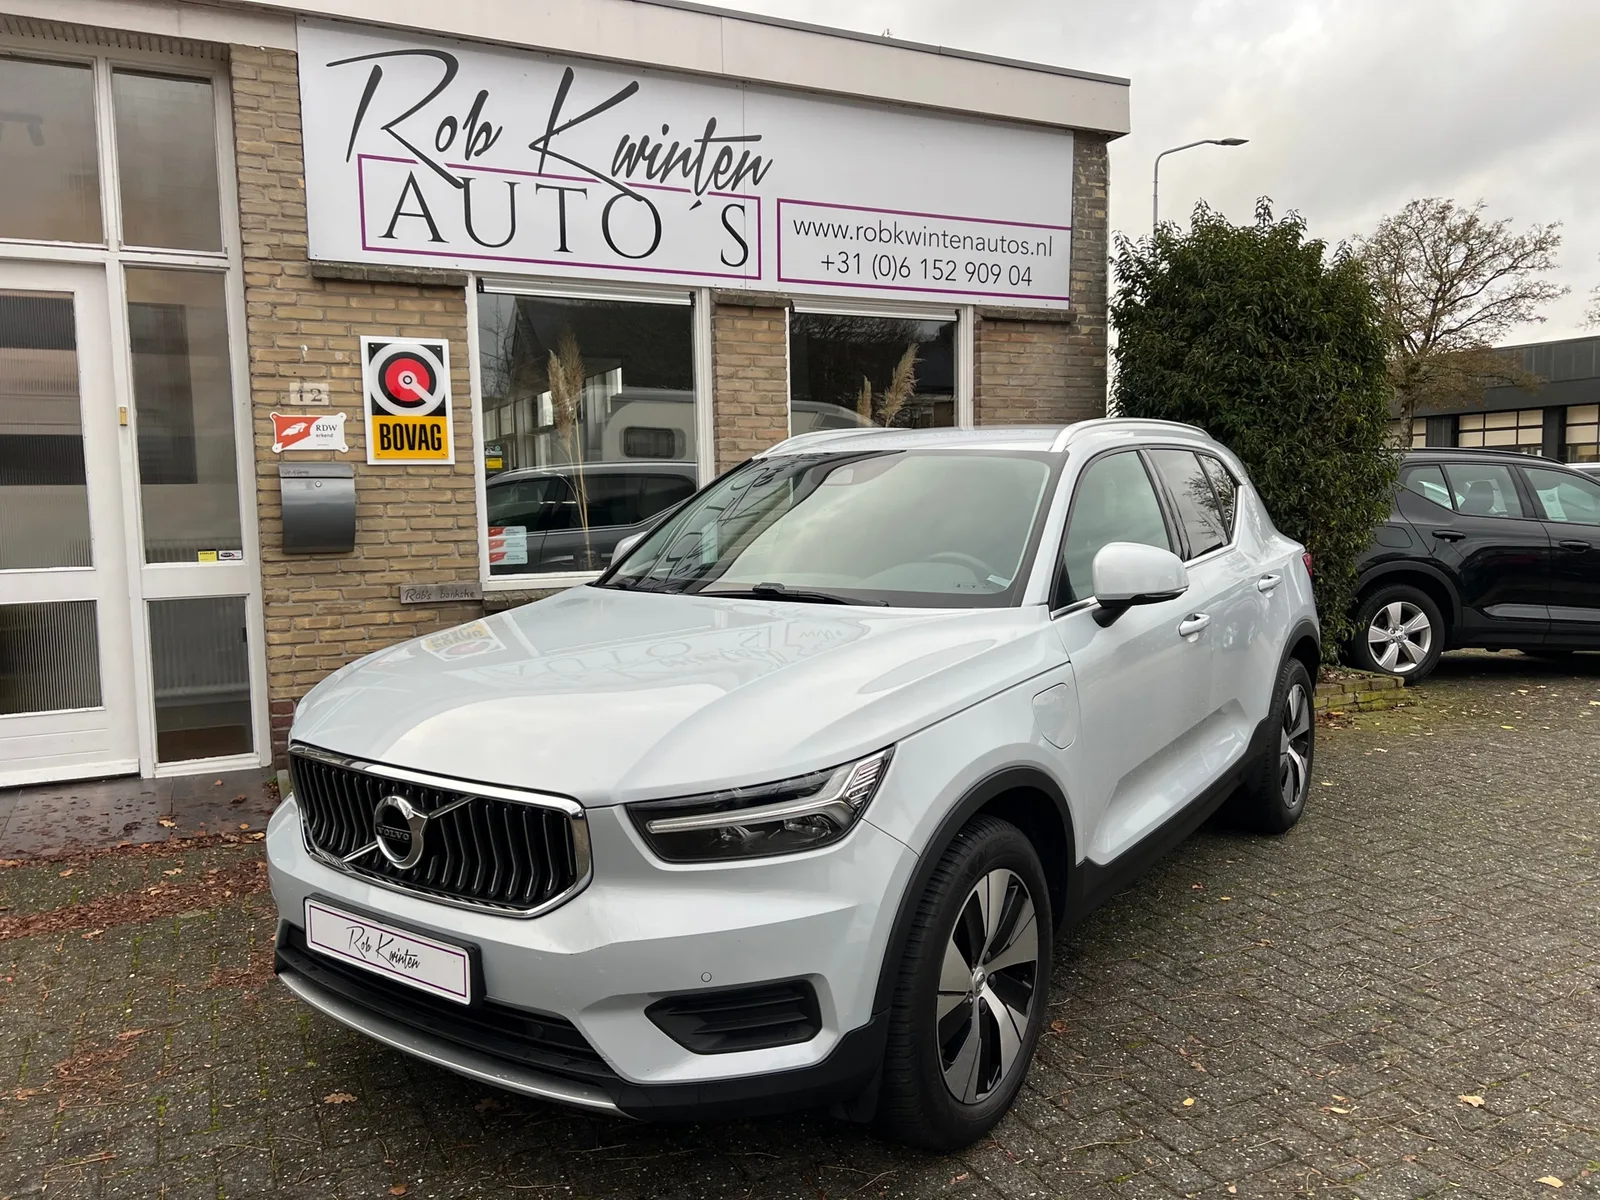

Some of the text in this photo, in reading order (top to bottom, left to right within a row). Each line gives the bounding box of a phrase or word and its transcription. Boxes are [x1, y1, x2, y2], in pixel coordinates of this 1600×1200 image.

[326, 48, 774, 201] Rob Kwinten
[793, 219, 1053, 257] www.robkwintenautos.nl
[821, 251, 1033, 287] +31 (0)6 152 909 04
[379, 423, 441, 451] BOVAG
[405, 588, 432, 601] Rob's
[377, 826, 410, 841] VOLVO
[346, 926, 420, 969] Rob Kwinten
